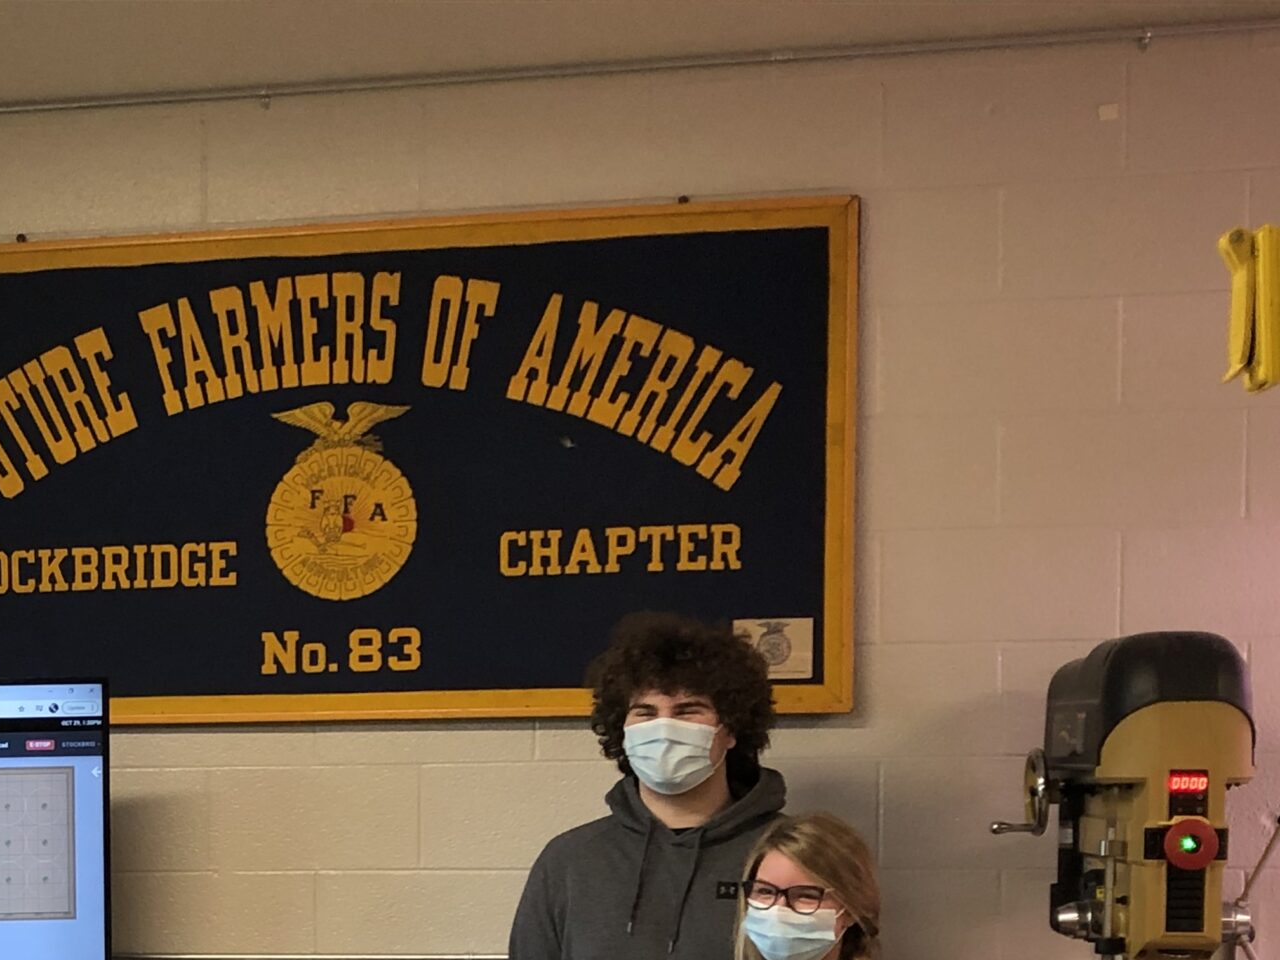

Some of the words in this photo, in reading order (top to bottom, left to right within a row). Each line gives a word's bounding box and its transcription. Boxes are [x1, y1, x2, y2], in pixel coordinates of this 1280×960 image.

[139, 272, 400, 416] FARMERS
[422, 276, 499, 389] OF
[507, 294, 781, 490] AMERICA
[500, 524, 741, 576] CHAPTER
[262, 631, 339, 674] No.
[349, 628, 421, 672] 83
[1171, 777, 1208, 790] 0000
